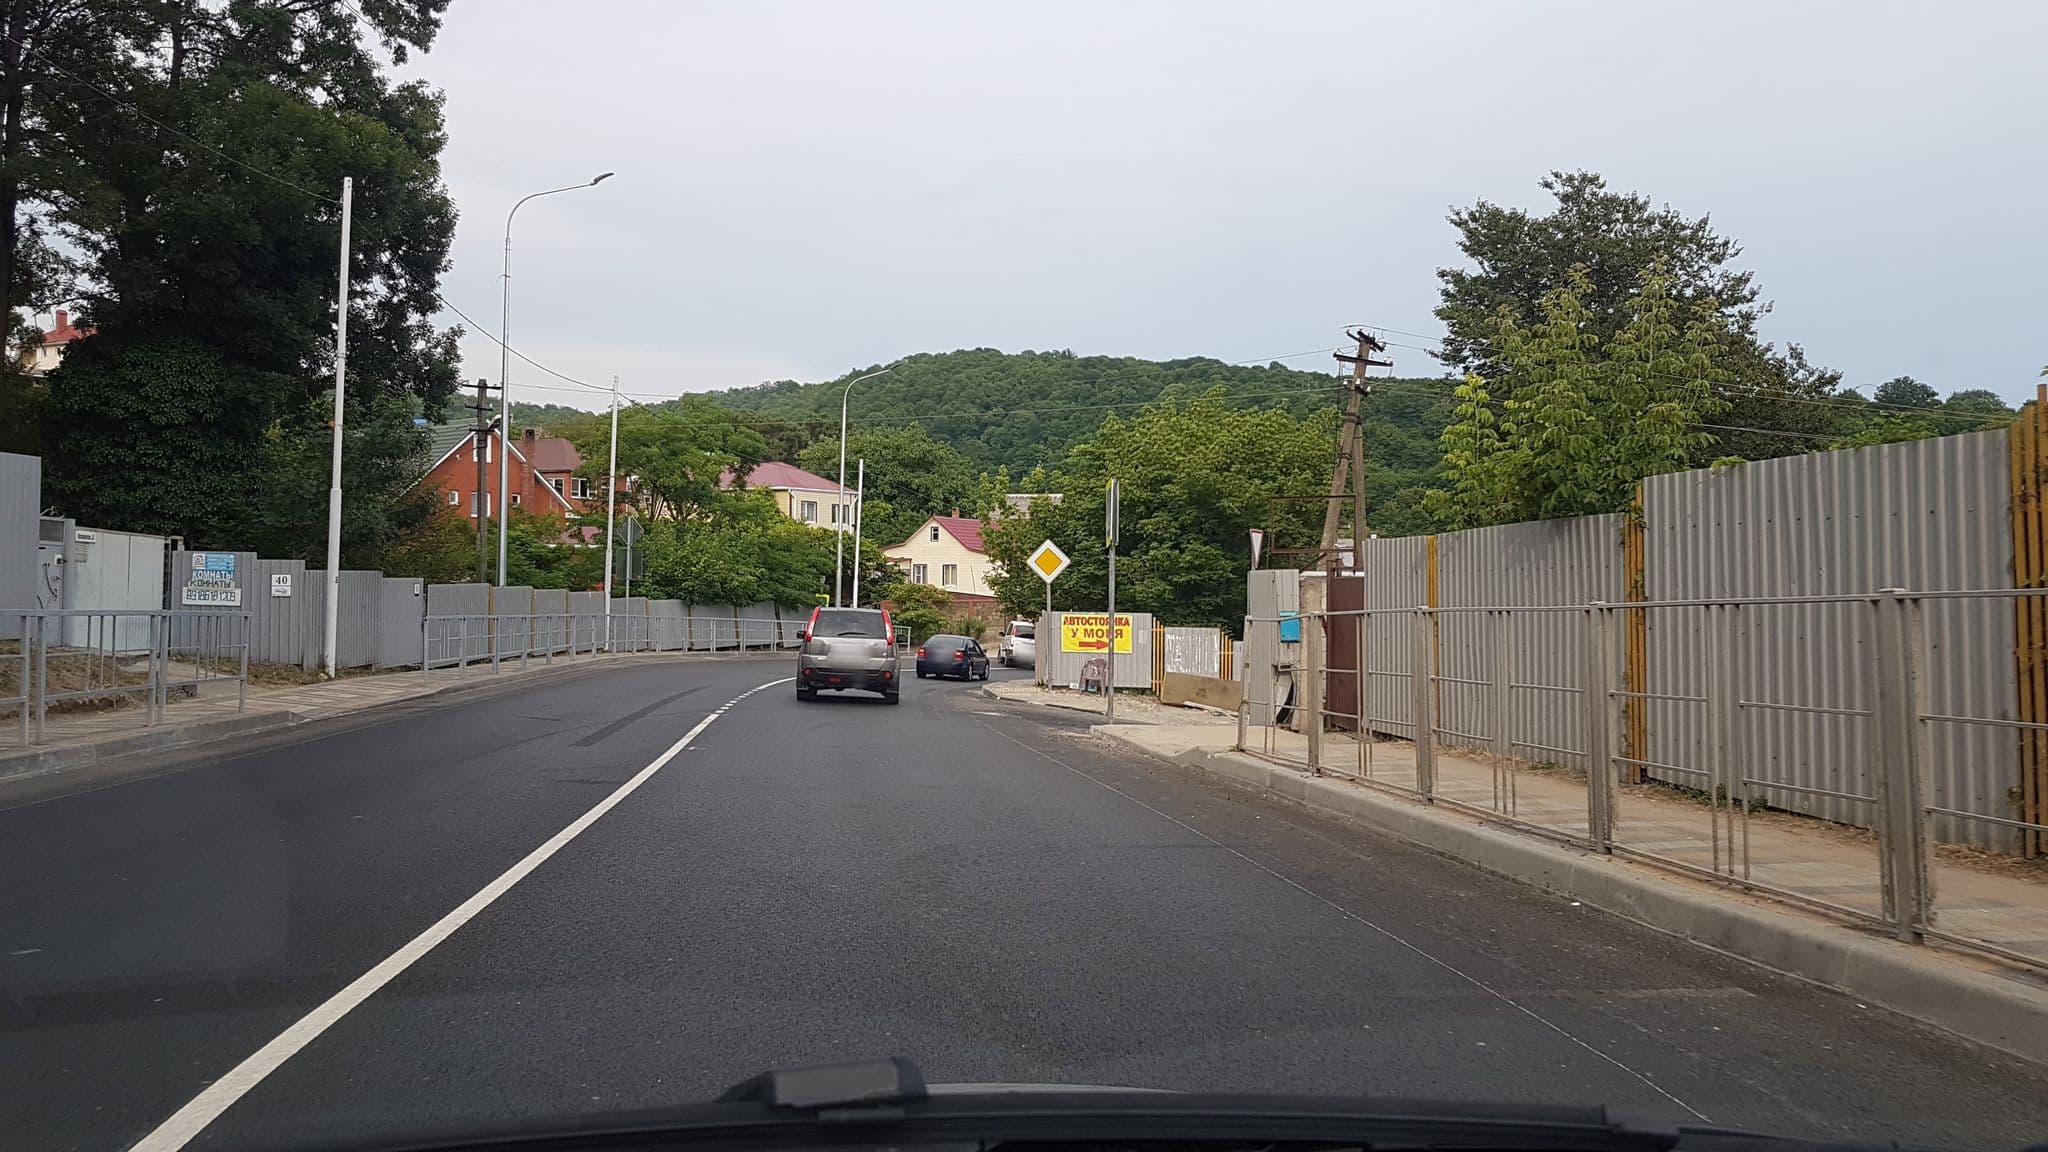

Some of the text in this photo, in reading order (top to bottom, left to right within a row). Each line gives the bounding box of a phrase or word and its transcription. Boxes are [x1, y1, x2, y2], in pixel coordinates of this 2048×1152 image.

[192, 570, 234, 580] КОМНАТЫ
[274, 575, 288, 585] 40
[190, 579, 232, 589] КОМНАТЫ
[1071, 628, 1079, 639] У
